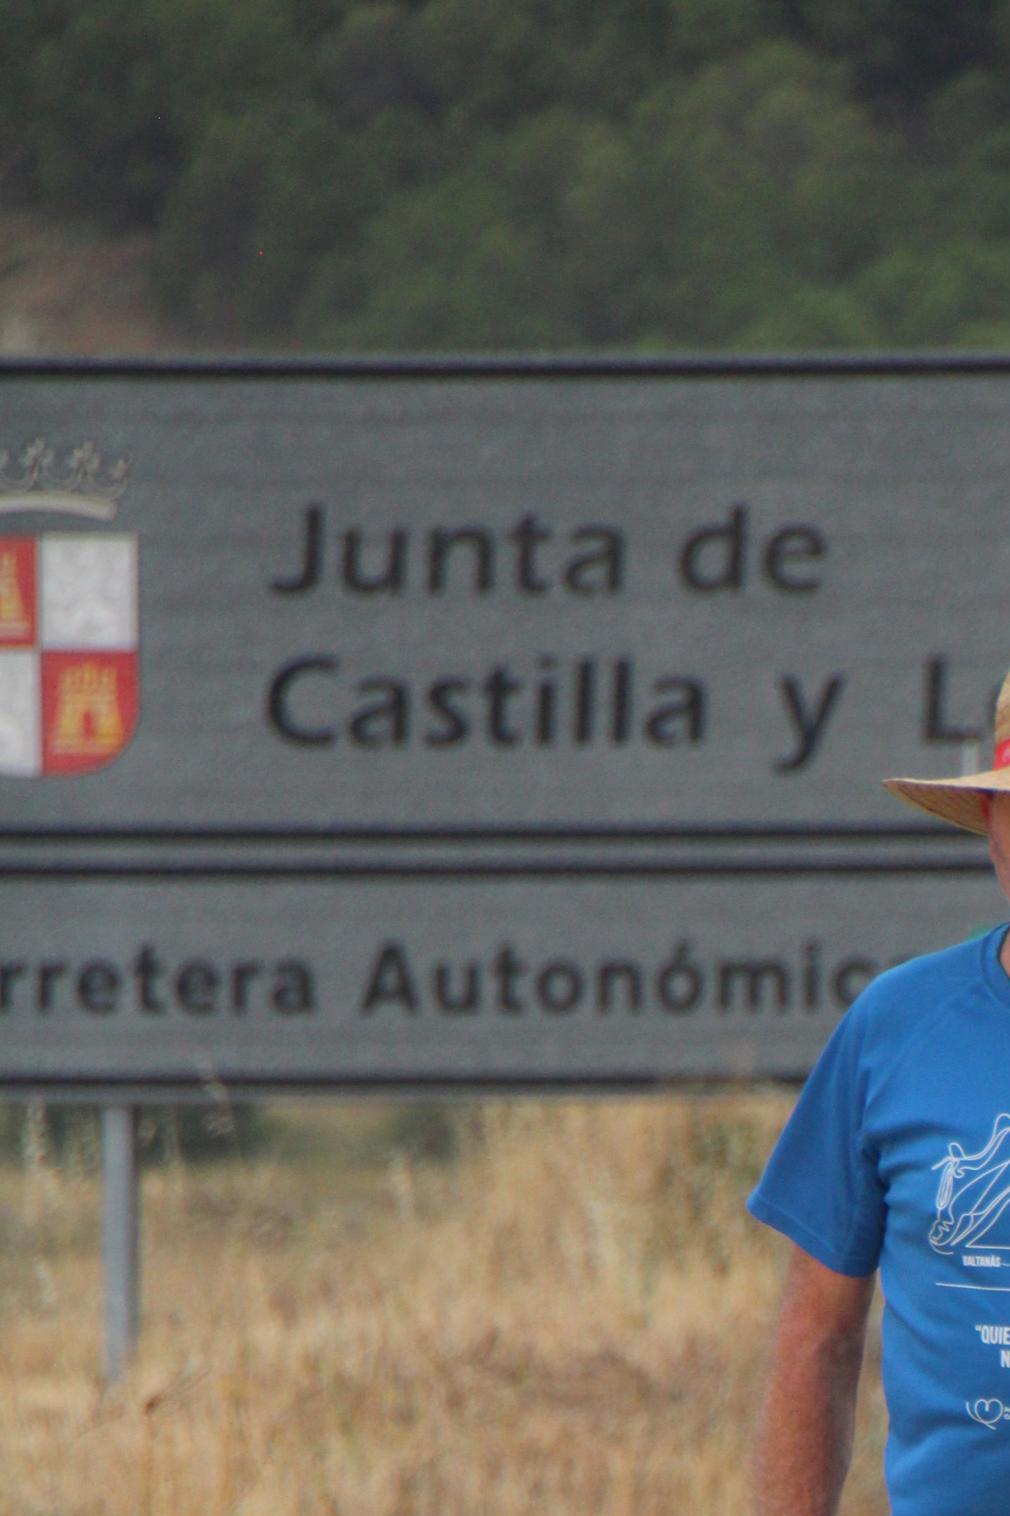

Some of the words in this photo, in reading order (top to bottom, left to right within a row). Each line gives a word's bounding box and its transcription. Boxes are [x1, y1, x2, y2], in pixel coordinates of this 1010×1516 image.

[272, 502, 625, 595] Junta
[679, 502, 826, 594] de
[266, 655, 706, 747] Castilla
[773, 673, 844, 773] y
[362, 938, 905, 1015] Autonómic
